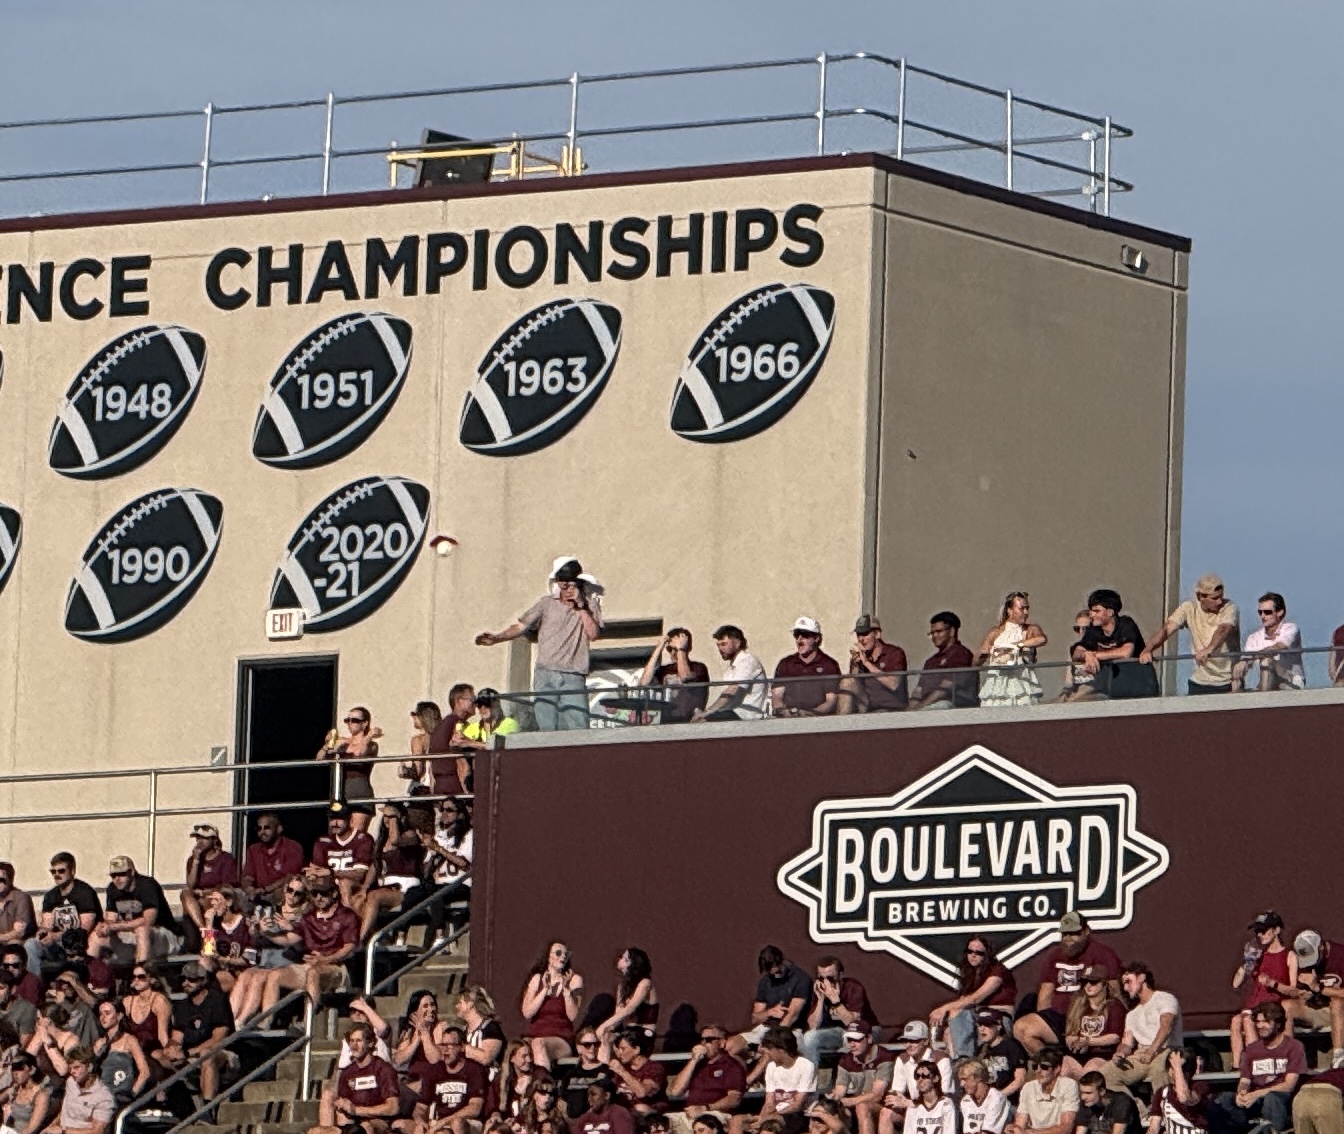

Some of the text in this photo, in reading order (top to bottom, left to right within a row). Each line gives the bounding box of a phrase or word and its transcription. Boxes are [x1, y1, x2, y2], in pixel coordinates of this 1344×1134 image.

[0, 203, 825, 324] NCE CHAMPIONSHIPS
[503, 356, 588, 397] 1963
[714, 342, 801, 385] 1966
[91, 381, 172, 423] 1948
[297, 369, 373, 411] 1951
[320, 521, 408, 564] 2020
[107, 545, 190, 586] 1990
[314, 561, 360, 600] -21
[835, 815, 1111, 914] BOULEVARD
[888, 894, 1056, 925] BREWING CO.
